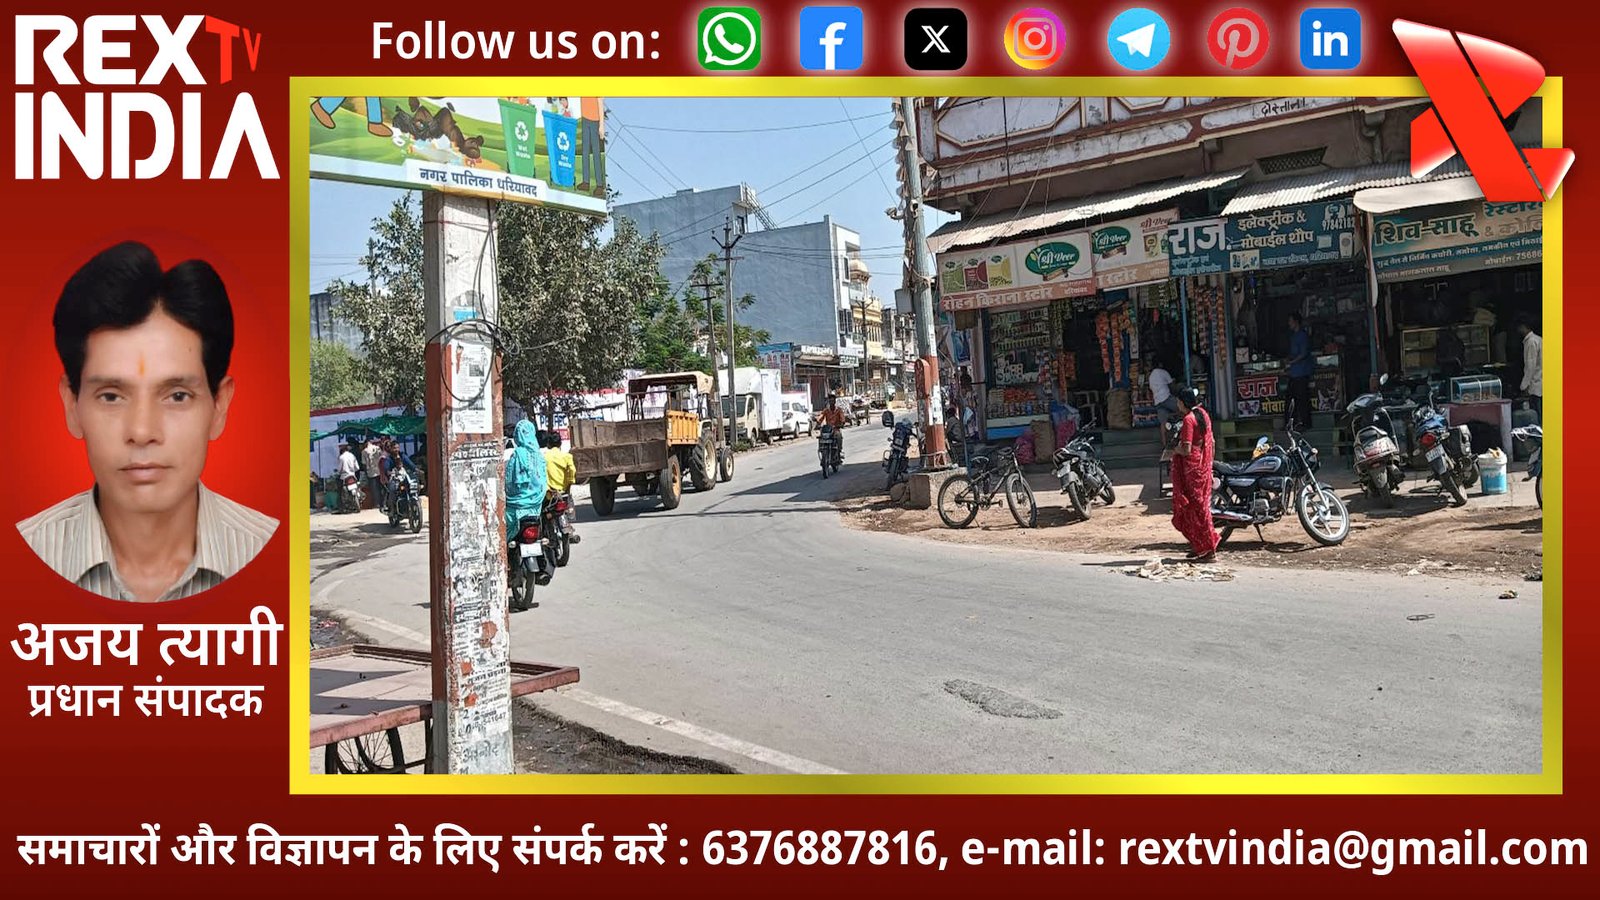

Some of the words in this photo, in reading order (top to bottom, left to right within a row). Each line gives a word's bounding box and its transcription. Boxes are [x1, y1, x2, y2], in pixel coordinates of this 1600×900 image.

[419, 168, 447, 182] नगर
[451, 170, 492, 188] पालिका
[497, 176, 537, 197] धरियावद
[1297, 210, 1307, 223] &
[1023, 284, 1053, 301] स्टोर
[1237, 376, 1278, 399] राज
